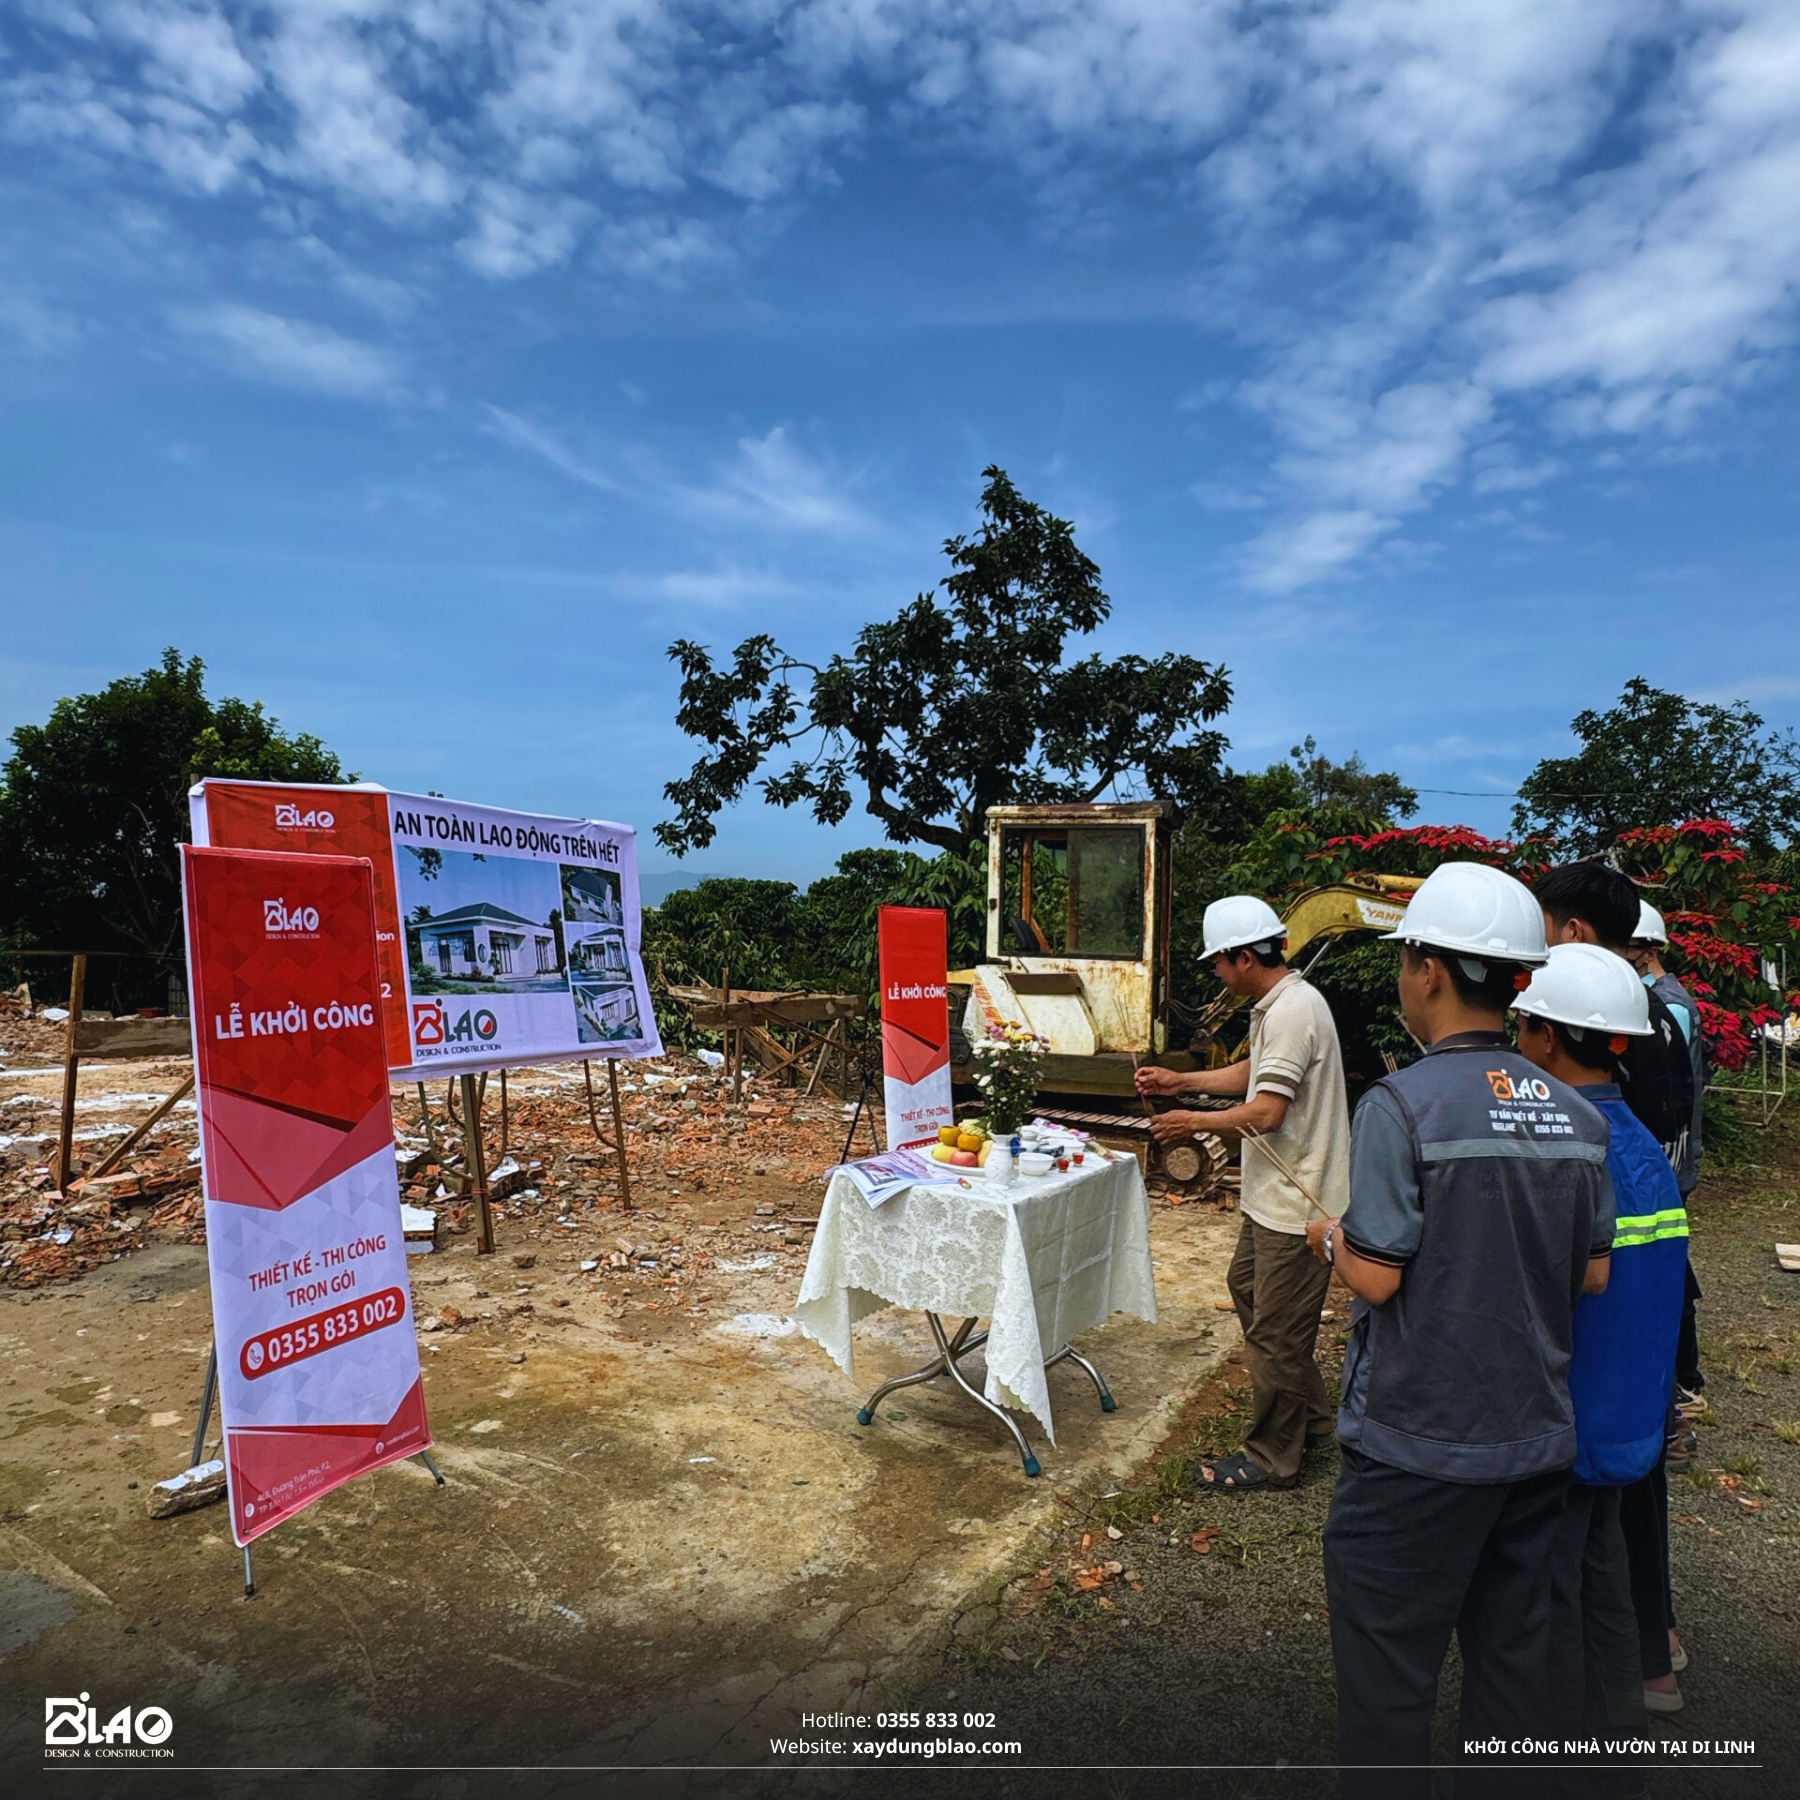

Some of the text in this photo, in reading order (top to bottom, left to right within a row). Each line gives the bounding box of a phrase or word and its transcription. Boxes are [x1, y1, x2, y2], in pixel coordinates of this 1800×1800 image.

[394, 811, 619, 864] AN TOÀN LAO ĐỘNG TRÊN HẾT
[376, 930, 395, 941] ion
[380, 983, 392, 998] 2
[215, 1000, 374, 1039] LỄ KHỞI CÔNG
[416, 1047, 442, 1057] DESIGN
[451, 1043, 502, 1054] CONSTRUCTION
[249, 1259, 289, 1292] THIẾT
[293, 1250, 312, 1277] KẾ
[321, 1247, 345, 1268] THI
[347, 1234, 386, 1260] CÔNG
[286, 1269, 356, 1308] TRỌN GÓI
[268, 1295, 397, 1363] 0355 833 002
